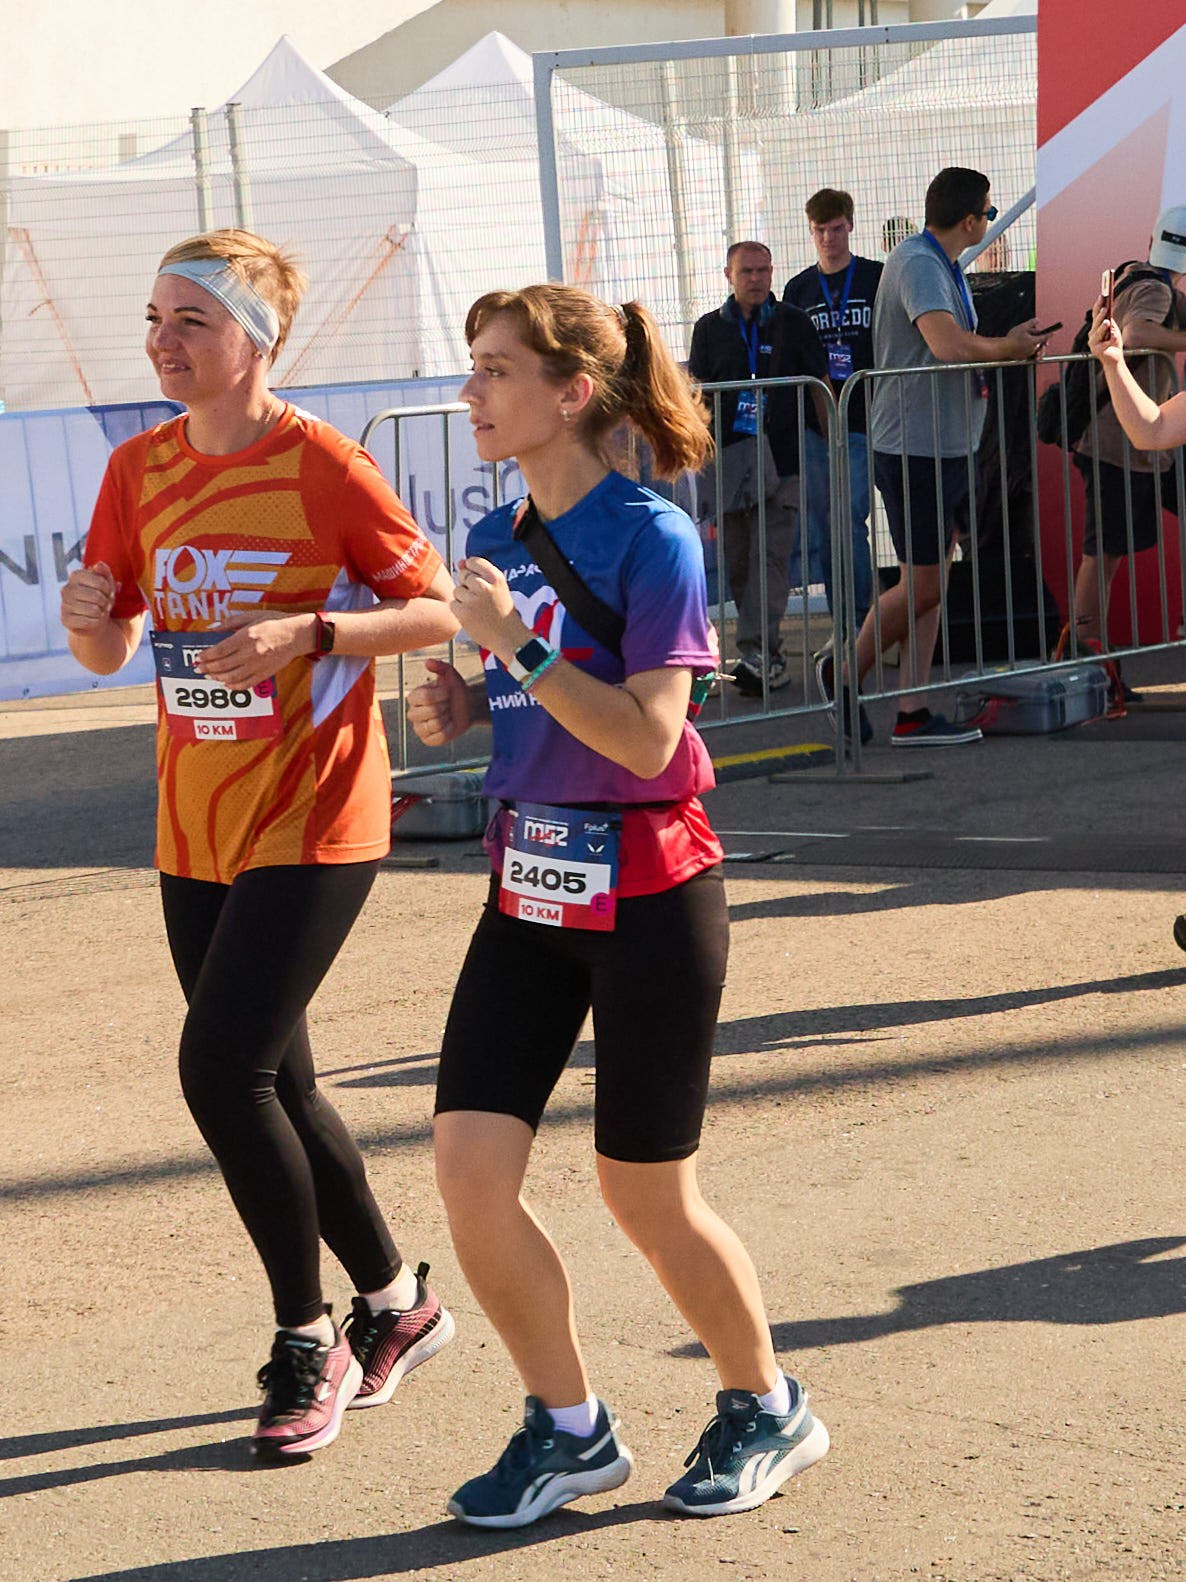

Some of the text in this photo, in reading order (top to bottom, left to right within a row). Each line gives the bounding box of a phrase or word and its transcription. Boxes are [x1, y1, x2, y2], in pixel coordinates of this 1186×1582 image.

[811, 306, 871, 332] ORPEDO
[154, 545, 233, 594] FOX
[154, 590, 232, 623] TANK
[175, 687, 252, 709] 2980
[196, 725, 234, 736] 10 KM
[510, 861, 587, 894] 2405
[520, 904, 560, 921] 10 KM
